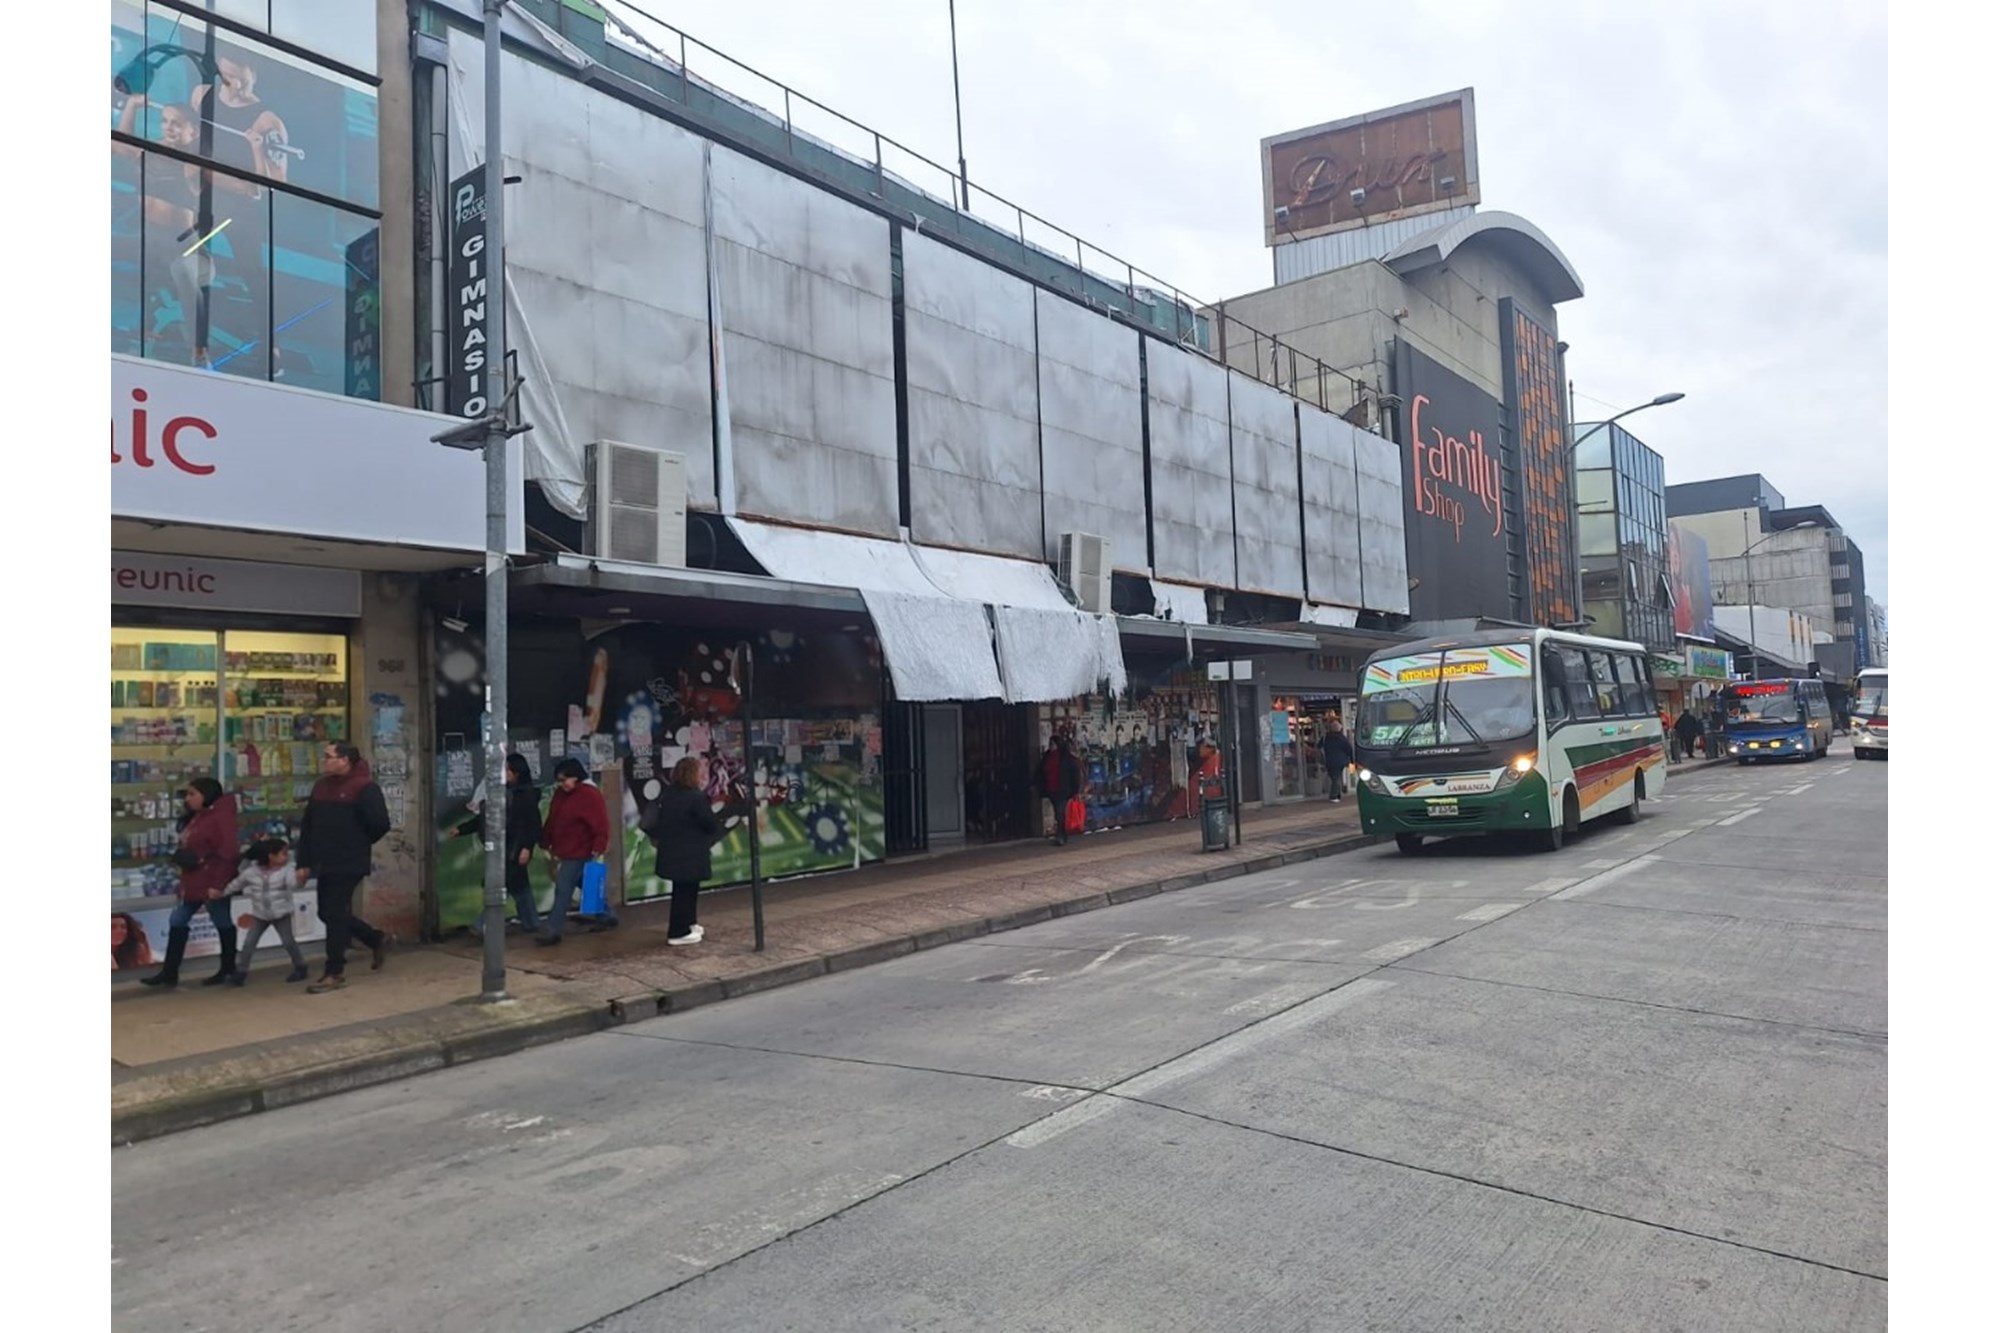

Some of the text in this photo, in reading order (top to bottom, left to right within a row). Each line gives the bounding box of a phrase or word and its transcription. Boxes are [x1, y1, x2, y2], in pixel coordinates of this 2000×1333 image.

[461, 234, 486, 417] GIMNASIO
[111, 388, 217, 475] ic
[1423, 477, 1465, 543] Shop
[111, 567, 216, 593] eunic
[1374, 726, 1405, 740] 5A
[1447, 784, 1491, 793] LABRANZA
